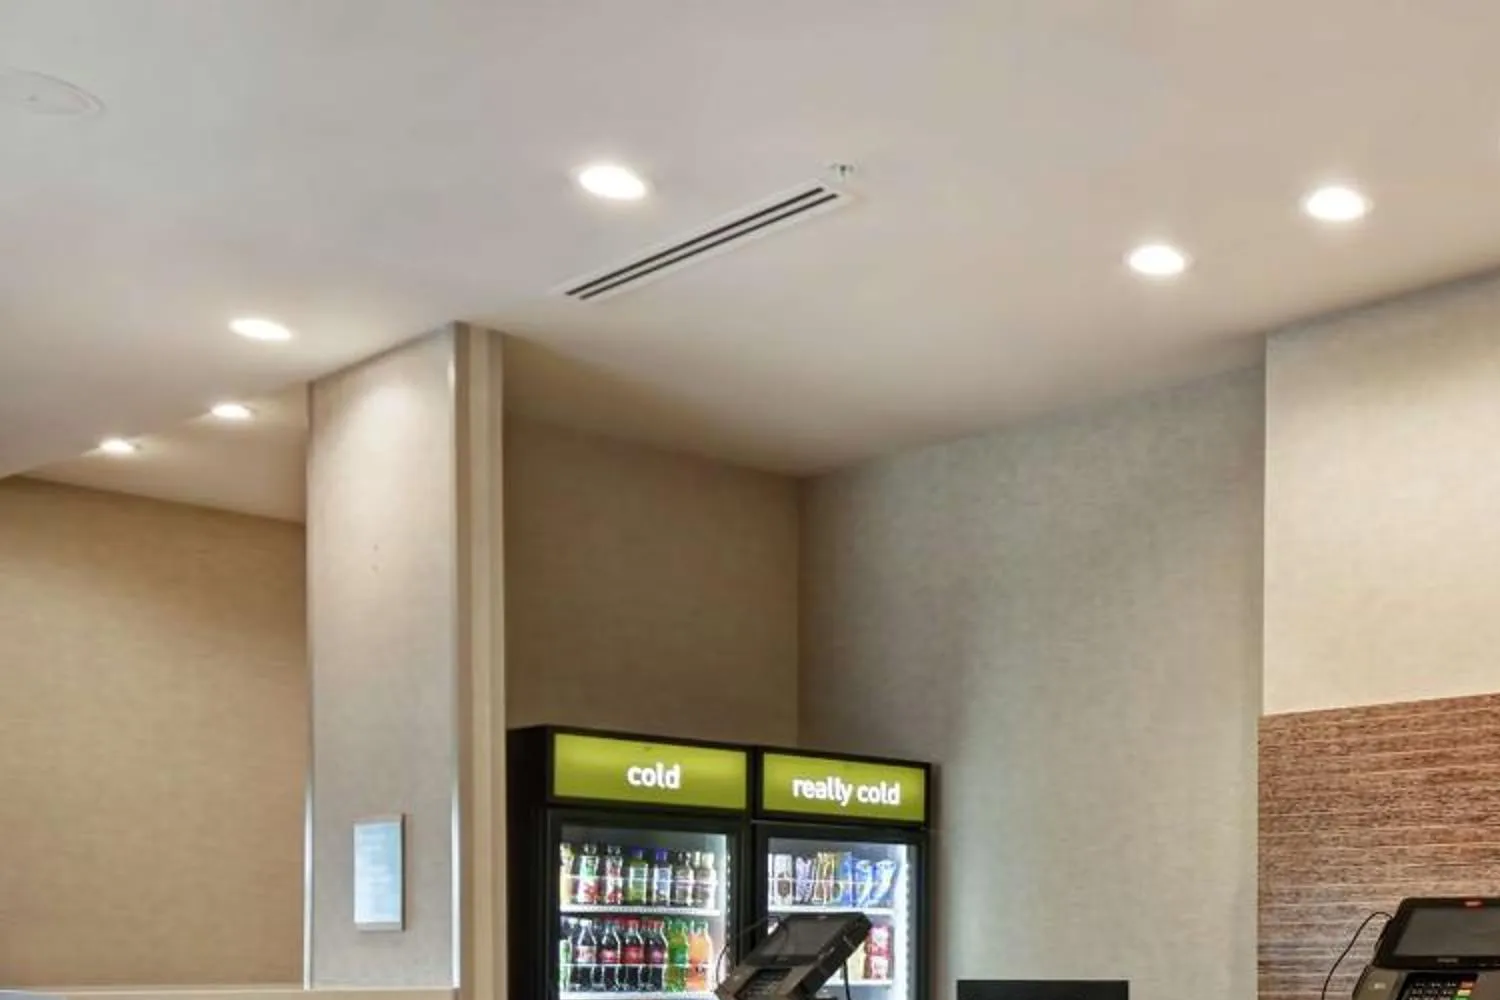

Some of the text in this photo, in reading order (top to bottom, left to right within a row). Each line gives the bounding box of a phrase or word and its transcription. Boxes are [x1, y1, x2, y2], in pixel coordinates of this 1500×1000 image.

[627, 762, 681, 790] cold
[792, 776, 901, 807] really cold
